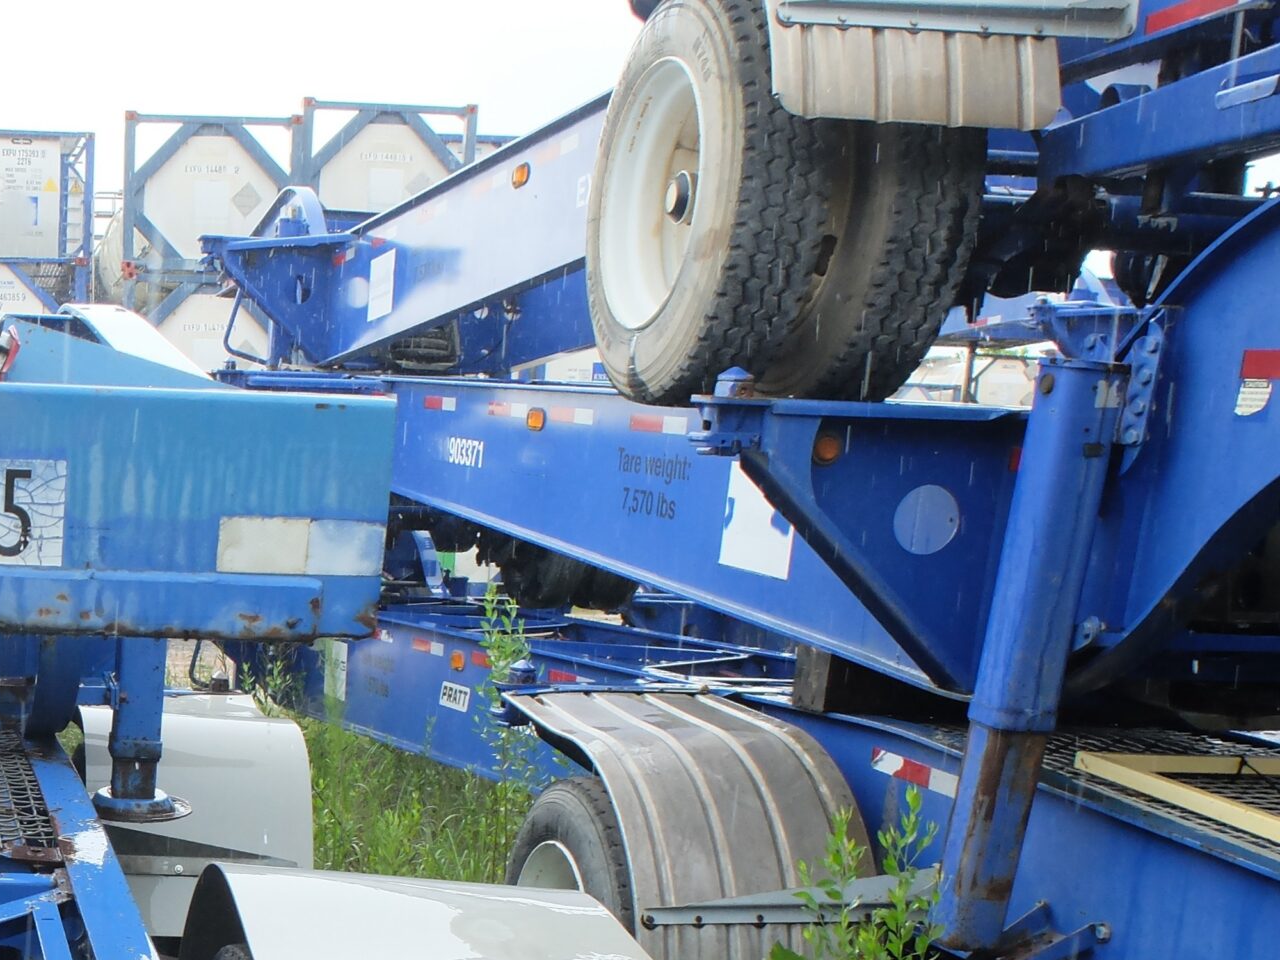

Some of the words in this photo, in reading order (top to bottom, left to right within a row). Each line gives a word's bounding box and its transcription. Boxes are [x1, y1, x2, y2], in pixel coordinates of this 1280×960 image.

[448, 436, 484, 469] 903371
[618, 447, 641, 474] Tare
[644, 452, 692, 485] weight:
[622, 487, 655, 517] 7,570
[656, 491, 676, 520] lbs
[441, 685, 469, 708] PRATT
